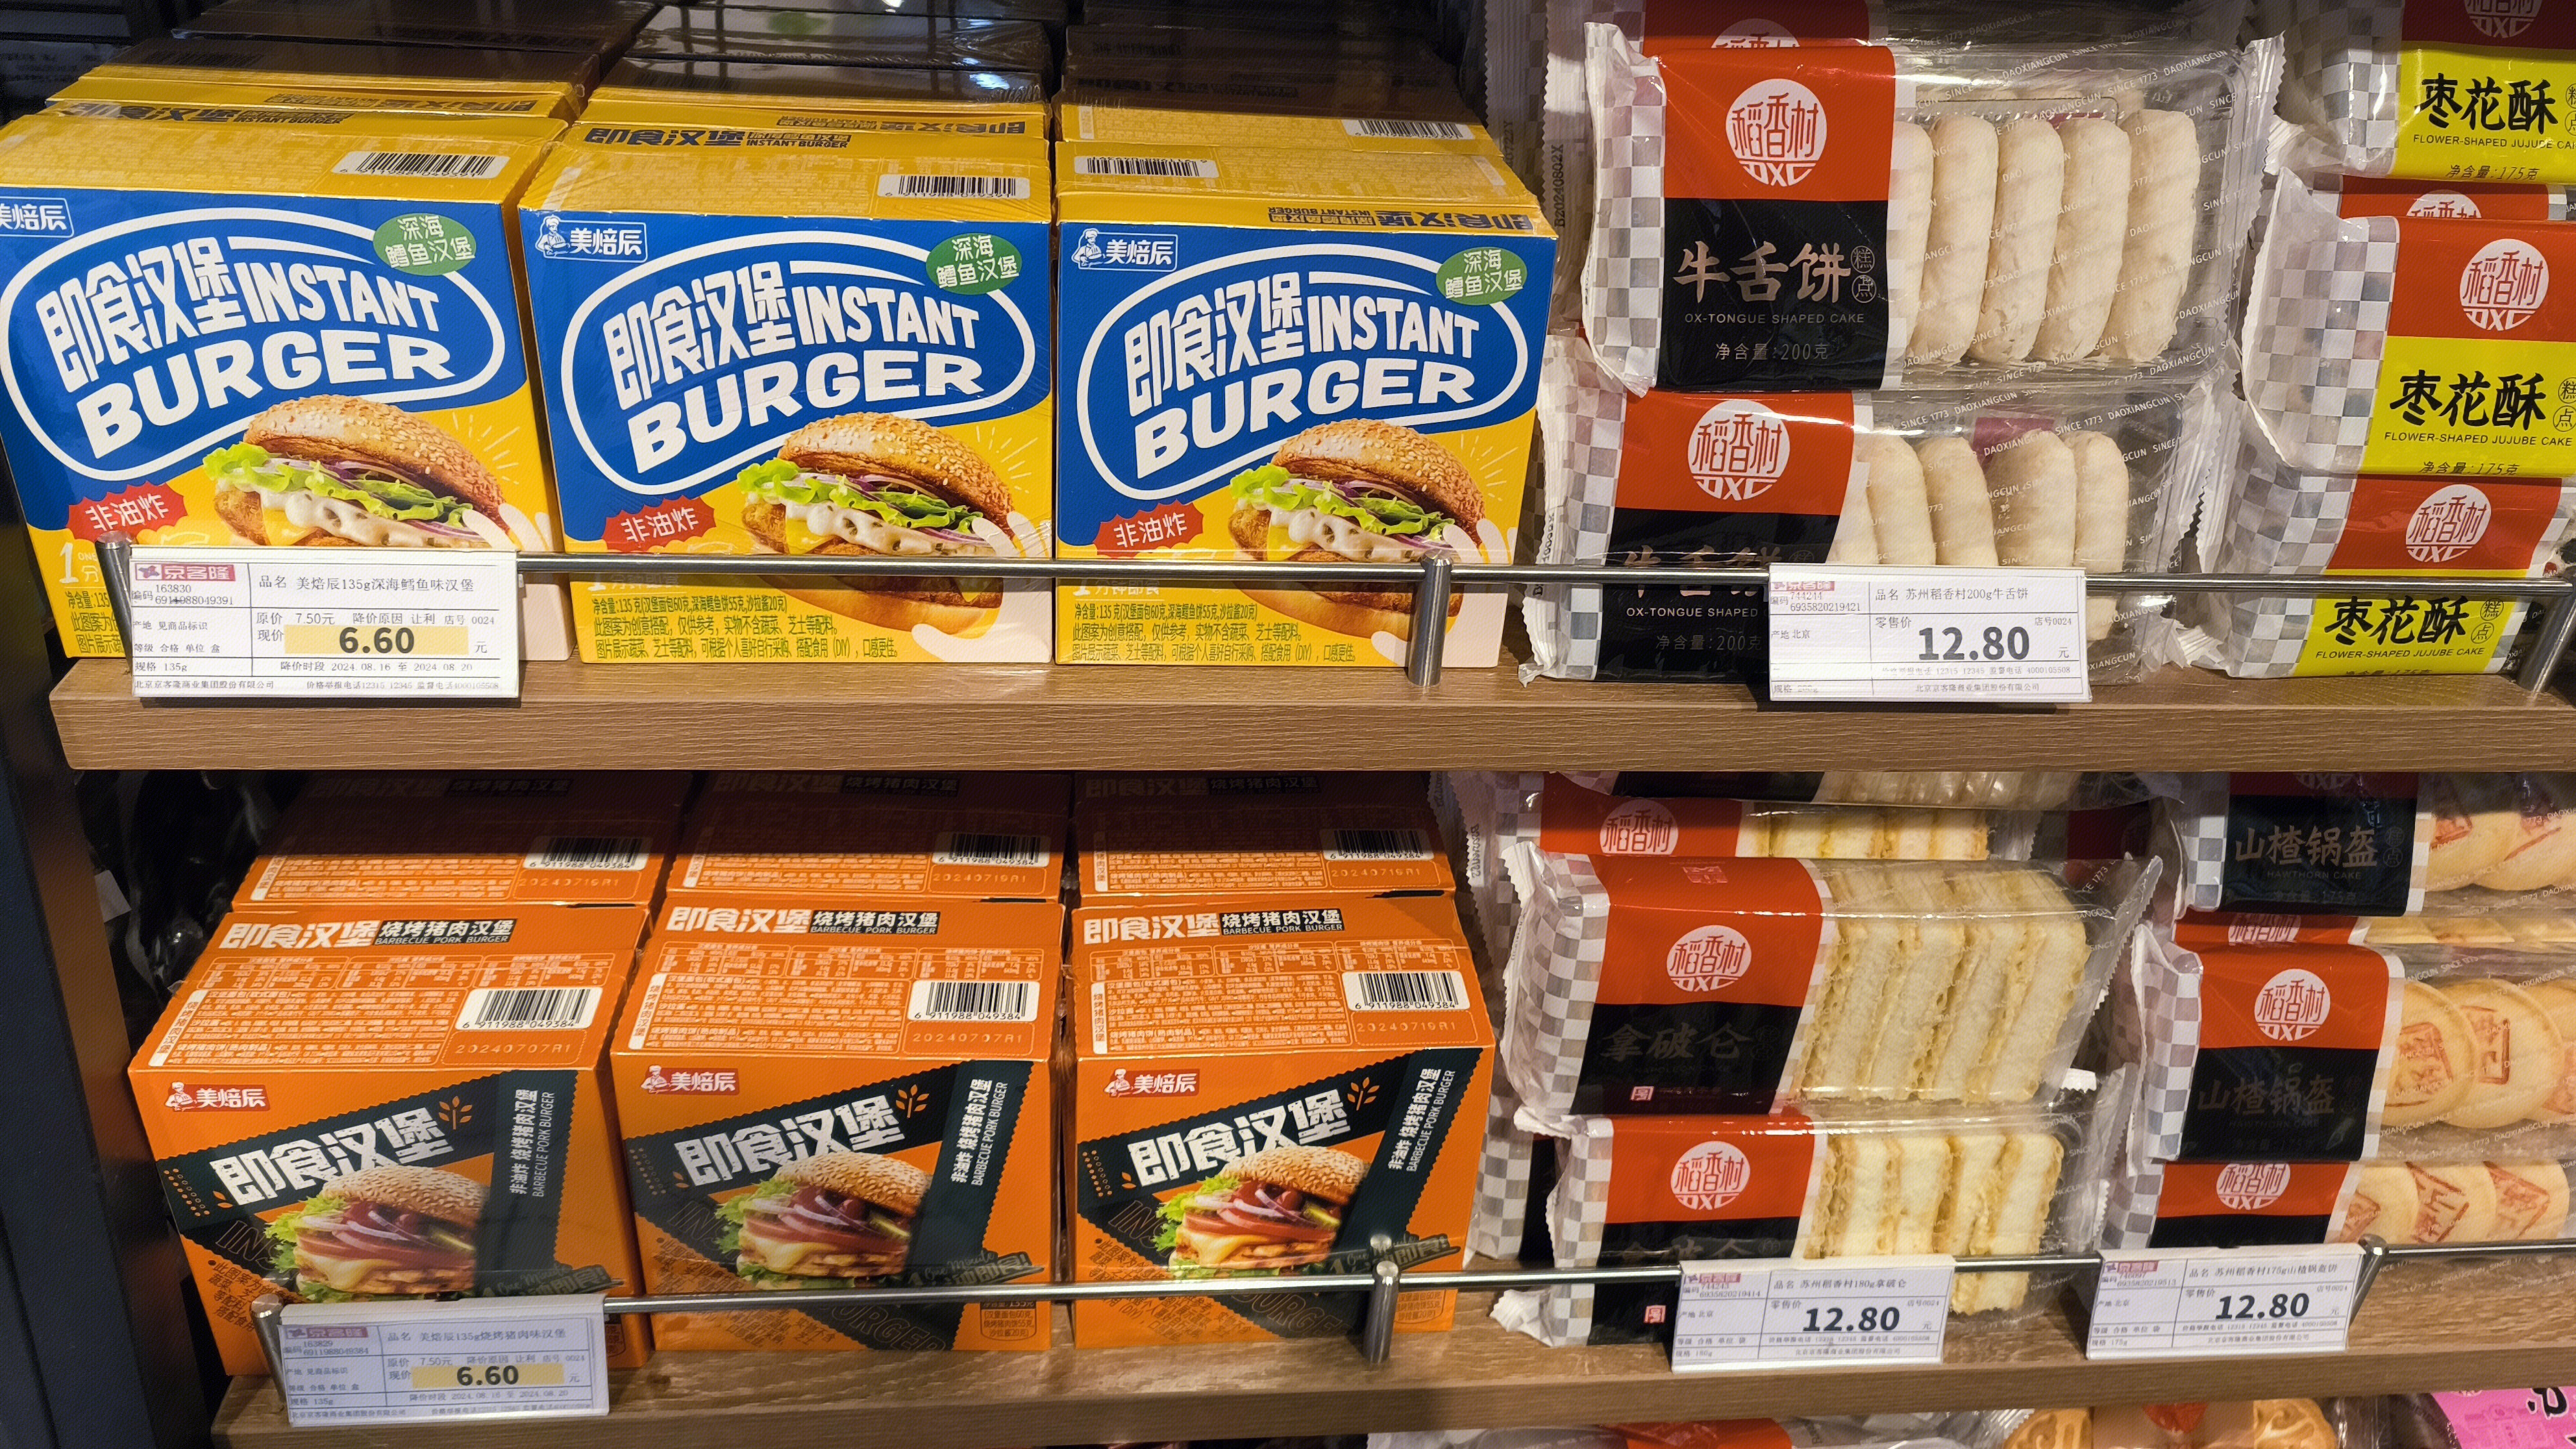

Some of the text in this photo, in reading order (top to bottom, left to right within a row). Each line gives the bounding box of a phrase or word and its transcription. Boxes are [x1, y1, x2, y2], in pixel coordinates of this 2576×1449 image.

[2002, 51, 2068, 79] DAOXIANGCUN
[2163, 49, 2227, 77] DAOXIANGCUN
[2421, 72, 2558, 134] 枣花酥
[1731, 92, 1818, 158] 稻香村
[2413, 134, 2507, 147] FLOWER-SHAPED
[395, 216, 444, 242] 深海
[569, 227, 645, 256] 美焙辰
[383, 239, 477, 269] 鳕鱼汉堡
[951, 234, 994, 261] 深海
[1106, 238, 1174, 266] 美焙辰
[1463, 249, 1502, 273] 深海
[935, 257, 1020, 288] 鳕鱼汉堡
[1444, 269, 1524, 300] 鳕鱼汉堡
[1673, 241, 1851, 303] 牛舌饼
[2463, 250, 2544, 306] 稻香村
[36, 237, 440, 390] 即食汉堡 INSTANT
[1685, 313, 1865, 324] OX-TONGUE SHAPED CAKE
[602, 261, 980, 410] 即食汉堡 INSTANT
[1124, 272, 1479, 417] 即食汉堡 INSTANT
[76, 329, 456, 460] BURGER
[1954, 390, 2018, 415] DAOXIANGCUN
[2389, 369, 2547, 430] 枣花酥
[626, 349, 984, 474] BURGER
[1134, 357, 1476, 479] BURGER
[1901, 408, 1950, 429] SINCE 1773
[2055, 395, 2172, 436] SINCE 1773 DAOXIANGCUN
[1692, 414, 1782, 473] 稻香村
[2384, 432, 2573, 447] FLOWER-SHAPED JUJUBE CAKE
[84, 493, 170, 532] 非油炸
[620, 504, 698, 545] 非油炸
[2408, 495, 2488, 544] 稻香村
[1113, 510, 1188, 549] 非油炸
[164, 565, 230, 580] 京客隆
[259, 575, 287, 589] 品名
[156, 584, 192, 593] 163830
[1875, 588, 2029, 601] 品名 苏州稻香村200g牛舌饼
[256, 612, 495, 626] 原价 7.50元 降价原因 让利 店号 0024
[1626, 607, 1758, 619] OX-TONGUE SHAPED
[1875, 616, 1912, 629] 零售价
[2324, 595, 2470, 645] 枣花酥
[258, 626, 488, 654] 现价 6.60 元
[1792, 630, 1811, 639] 北京
[1918, 626, 2070, 660] 12.80 元
[134, 662, 156, 672] 规格
[280, 662, 473, 672] 降价时段 2024.08.16 至 2024.08.20
[2315, 647, 2484, 660] FLOWER-SHAPED JUJUBE CAKE
[2235, 825, 2377, 867] 山楂锅盔
[2334, 871, 2362, 880] CAKE
[218, 920, 514, 949] 即食汉堡 烧烤猪肉汉堡
[667, 907, 938, 934] 即食汉堡 烧烤猪肉汉堡
[811, 926, 939, 935] BARBECUE PORK BURGER
[1084, 910, 1342, 944] 即食汉堡 烧烤猪肉汉堡
[1222, 923, 1344, 935] BARBECUE PORK BURGER
[466, 935, 509, 944] BURGER
[1671, 935, 1746, 974] 稻香村
[2257, 979, 2325, 1022] 稻香村
[530, 1020, 575, 1028] 049384
[926, 1011, 973, 1020] 911988
[671, 1071, 736, 1092] 美焙辰
[1133, 1073, 1197, 1095] 美焙辰
[195, 1087, 266, 1109] 美焙辰
[971, 1082, 1008, 1186] BARBECUE PORK BURGER
[1406, 1070, 1455, 1172] BARBECUE PORK BURGER
[532, 1091, 556, 1197] BARBECUE PORK BURGER
[674, 1095, 906, 1186] 即食汉堡
[1128, 1089, 1351, 1187] 即食汉堡
[209, 1106, 454, 1206] 即食汉堡
[1675, 1152, 1745, 1193] 稻香村
[1774, 1280, 1794, 1290] 品名
[1771, 1299, 1802, 1309] 零售价
[2216, 1293, 2310, 1320] 12.80
[1803, 1307, 1900, 1332] 12.80
[388, 1331, 411, 1342] 品名
[456, 1365, 519, 1387] 6.60
[569, 1372, 580, 1383] 元
